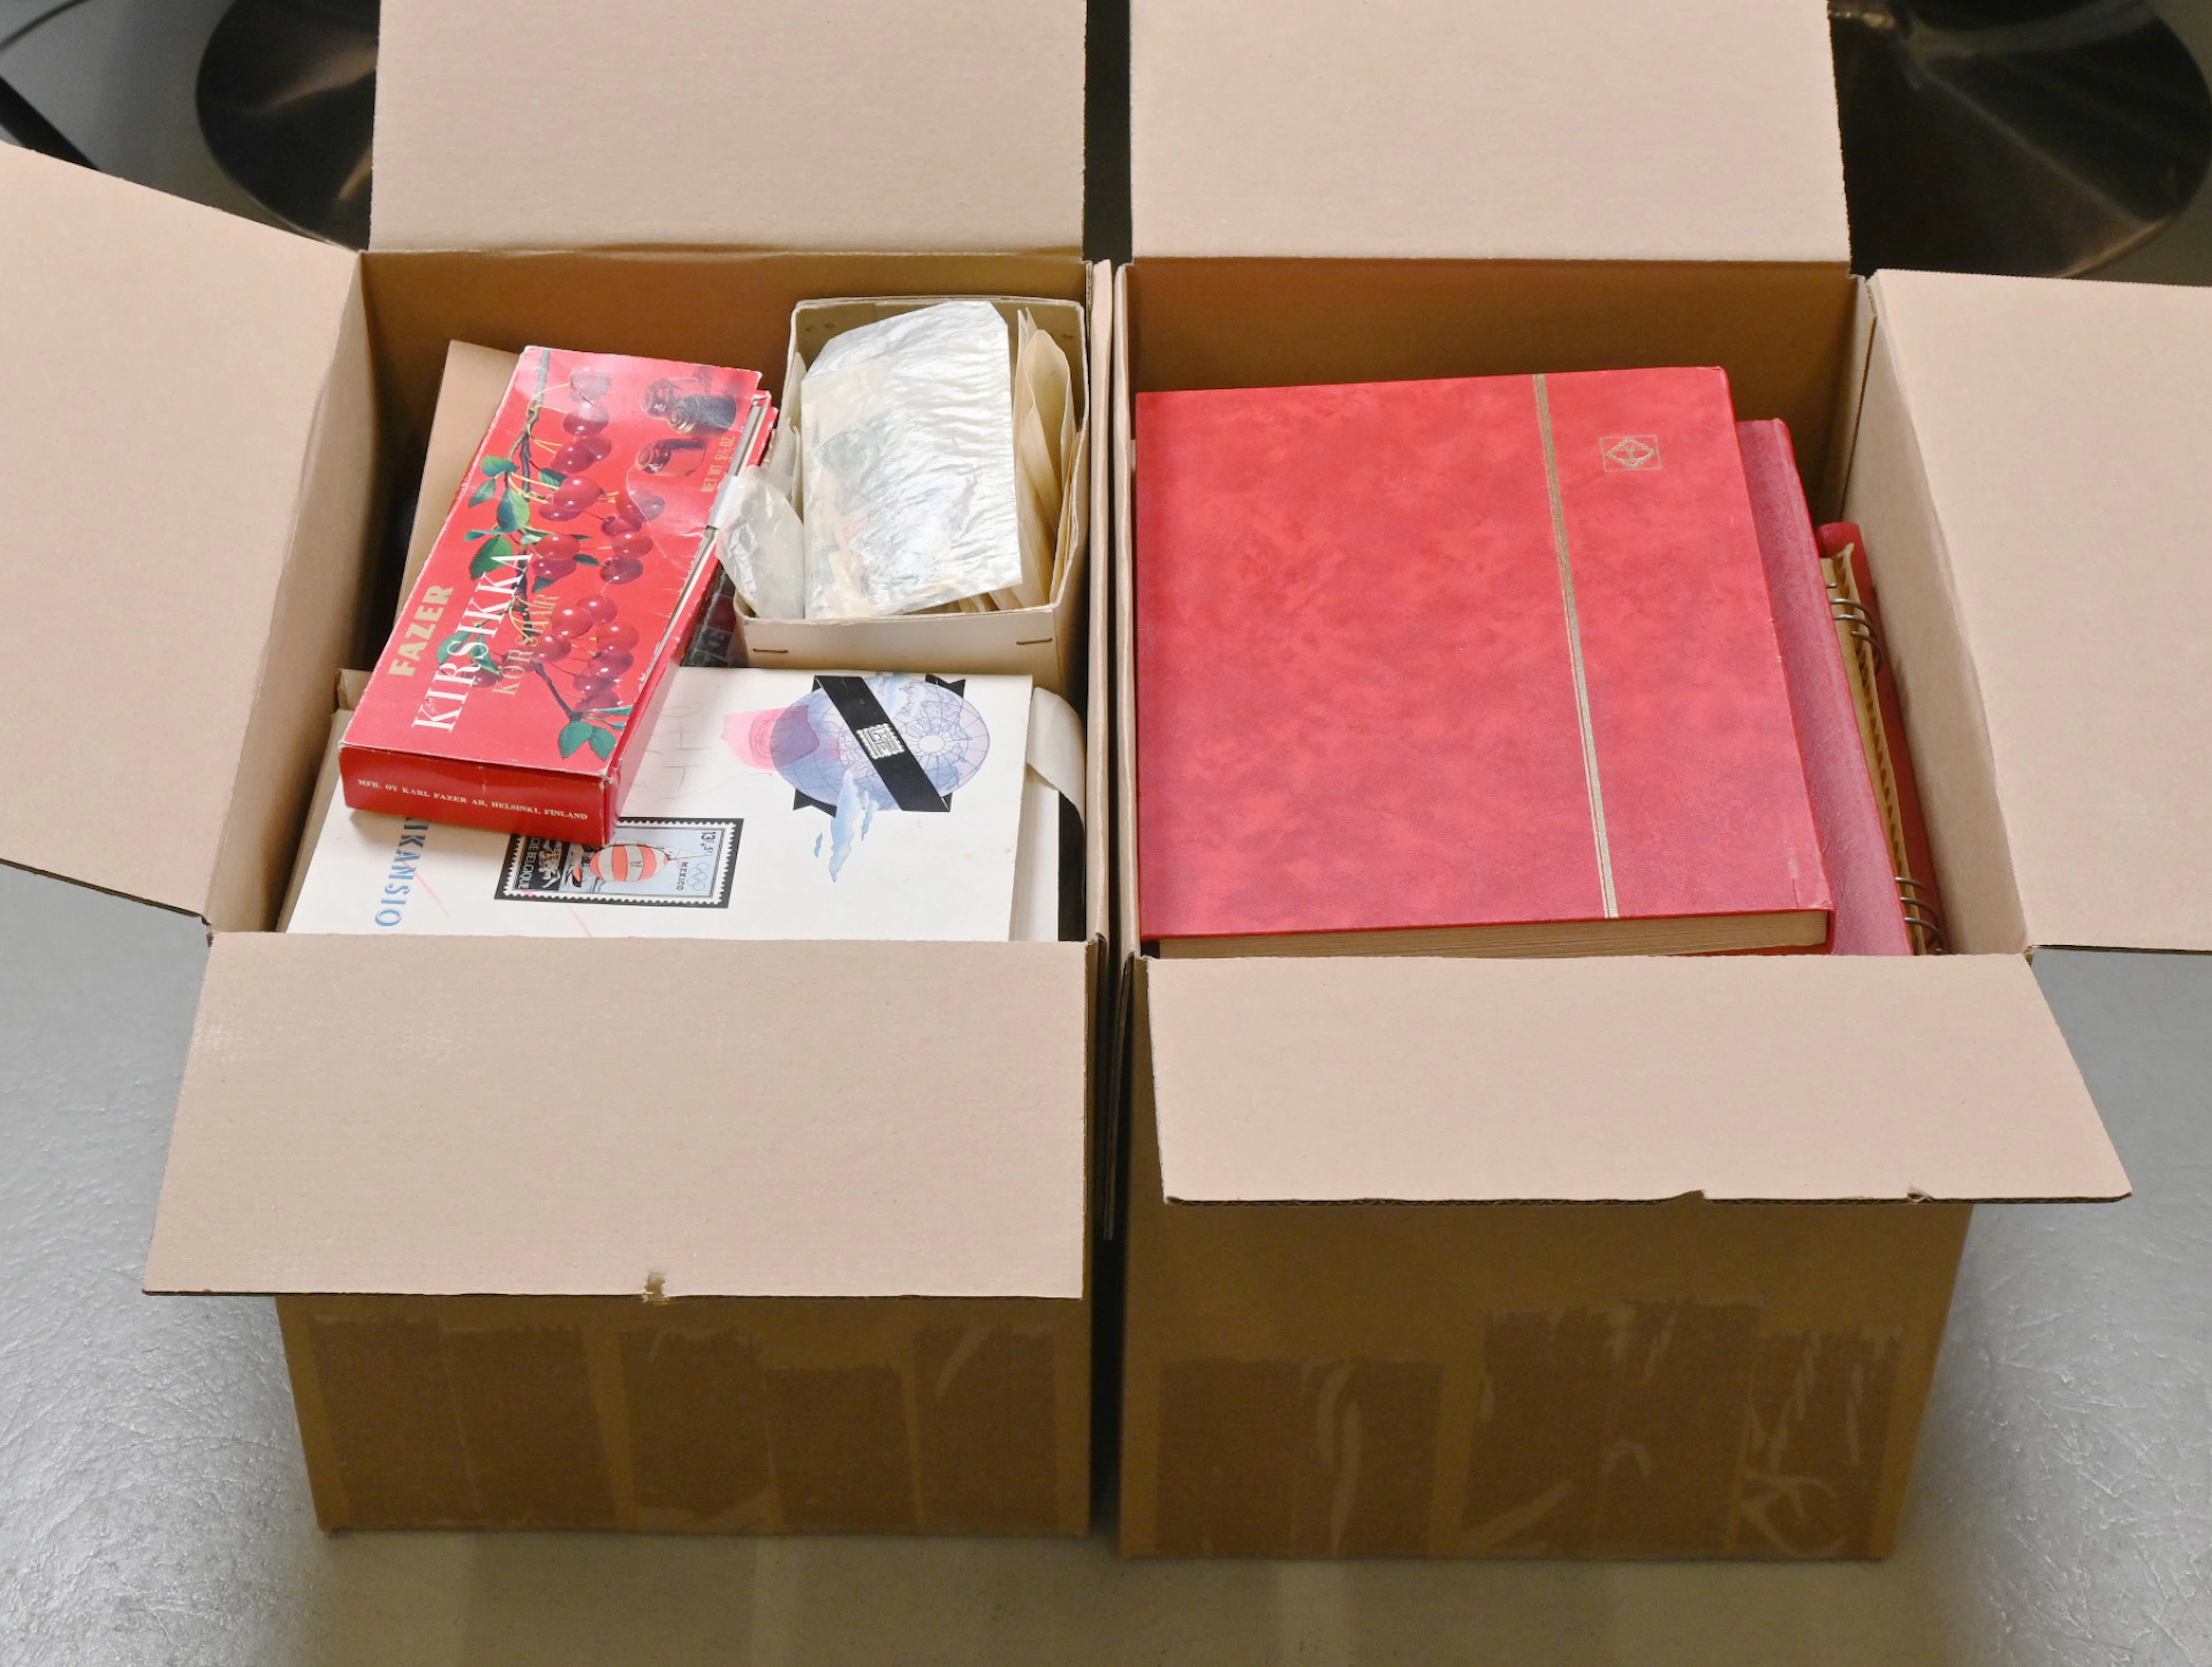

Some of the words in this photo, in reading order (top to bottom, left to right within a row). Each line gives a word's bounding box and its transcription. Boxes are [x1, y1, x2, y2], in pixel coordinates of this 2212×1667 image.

[388, 585, 454, 676] FAZER
[411, 552, 534, 733] KIRSIKKA
[385, 783, 398, 792] OY
[402, 787, 430, 797] KARL
[433, 793, 468, 803] FAZER
[544, 809, 588, 820] FINLAND
[375, 817, 429, 927] IKANSIO
[676, 861, 689, 891] MEXICO
